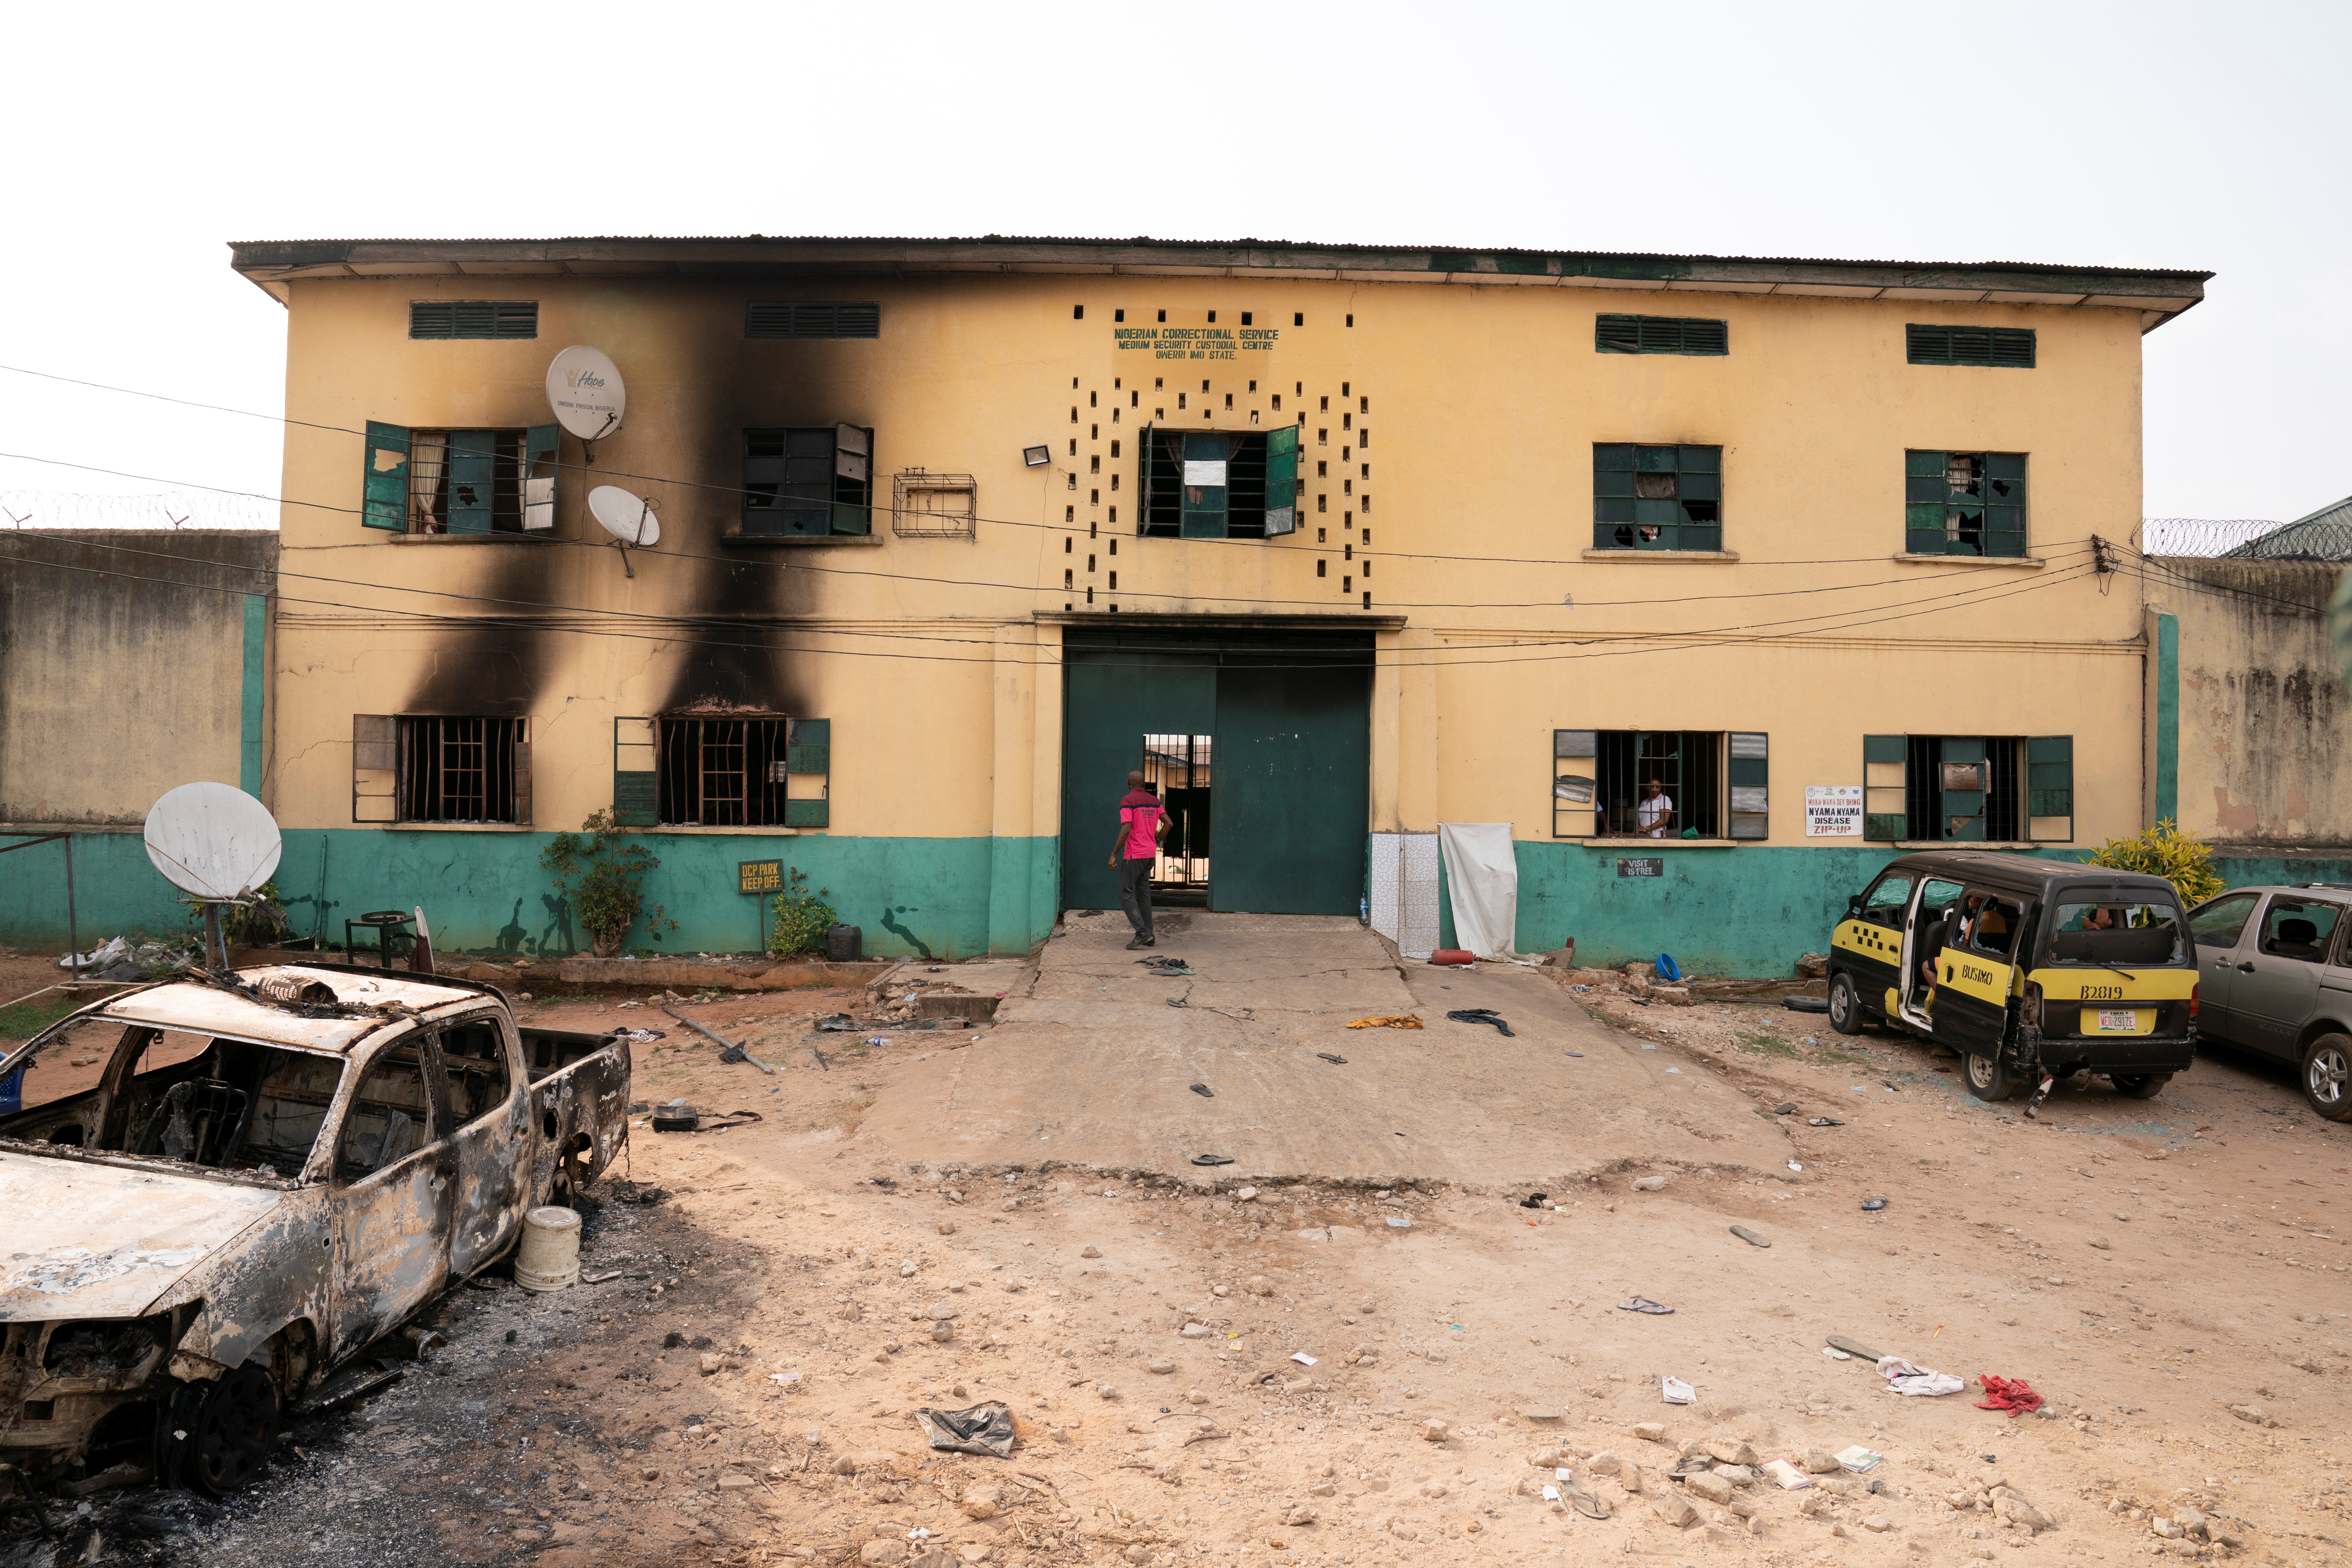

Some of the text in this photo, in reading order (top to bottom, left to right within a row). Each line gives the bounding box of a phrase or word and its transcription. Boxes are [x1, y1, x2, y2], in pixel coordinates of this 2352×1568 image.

[1114, 328, 1279, 340] NIGERIAN CORRECTIONAL SERVICE
[1119, 340, 1273, 350] MEDIUM SECURITY CUSTODIAL CENTRE
[1156, 350, 1236, 360] OWERRI IMO STATE.
[577, 370, 605, 387] Hope
[1809, 807, 1860, 816] NYAMA NYAMA
[1813, 826, 1851, 834] ZIP-UP
[742, 863, 778, 877] DCP PARK
[1636, 867, 1655, 875] FREE.
[742, 875, 781, 890] KEEP OFF.
[2080, 985, 2122, 999] B2819
